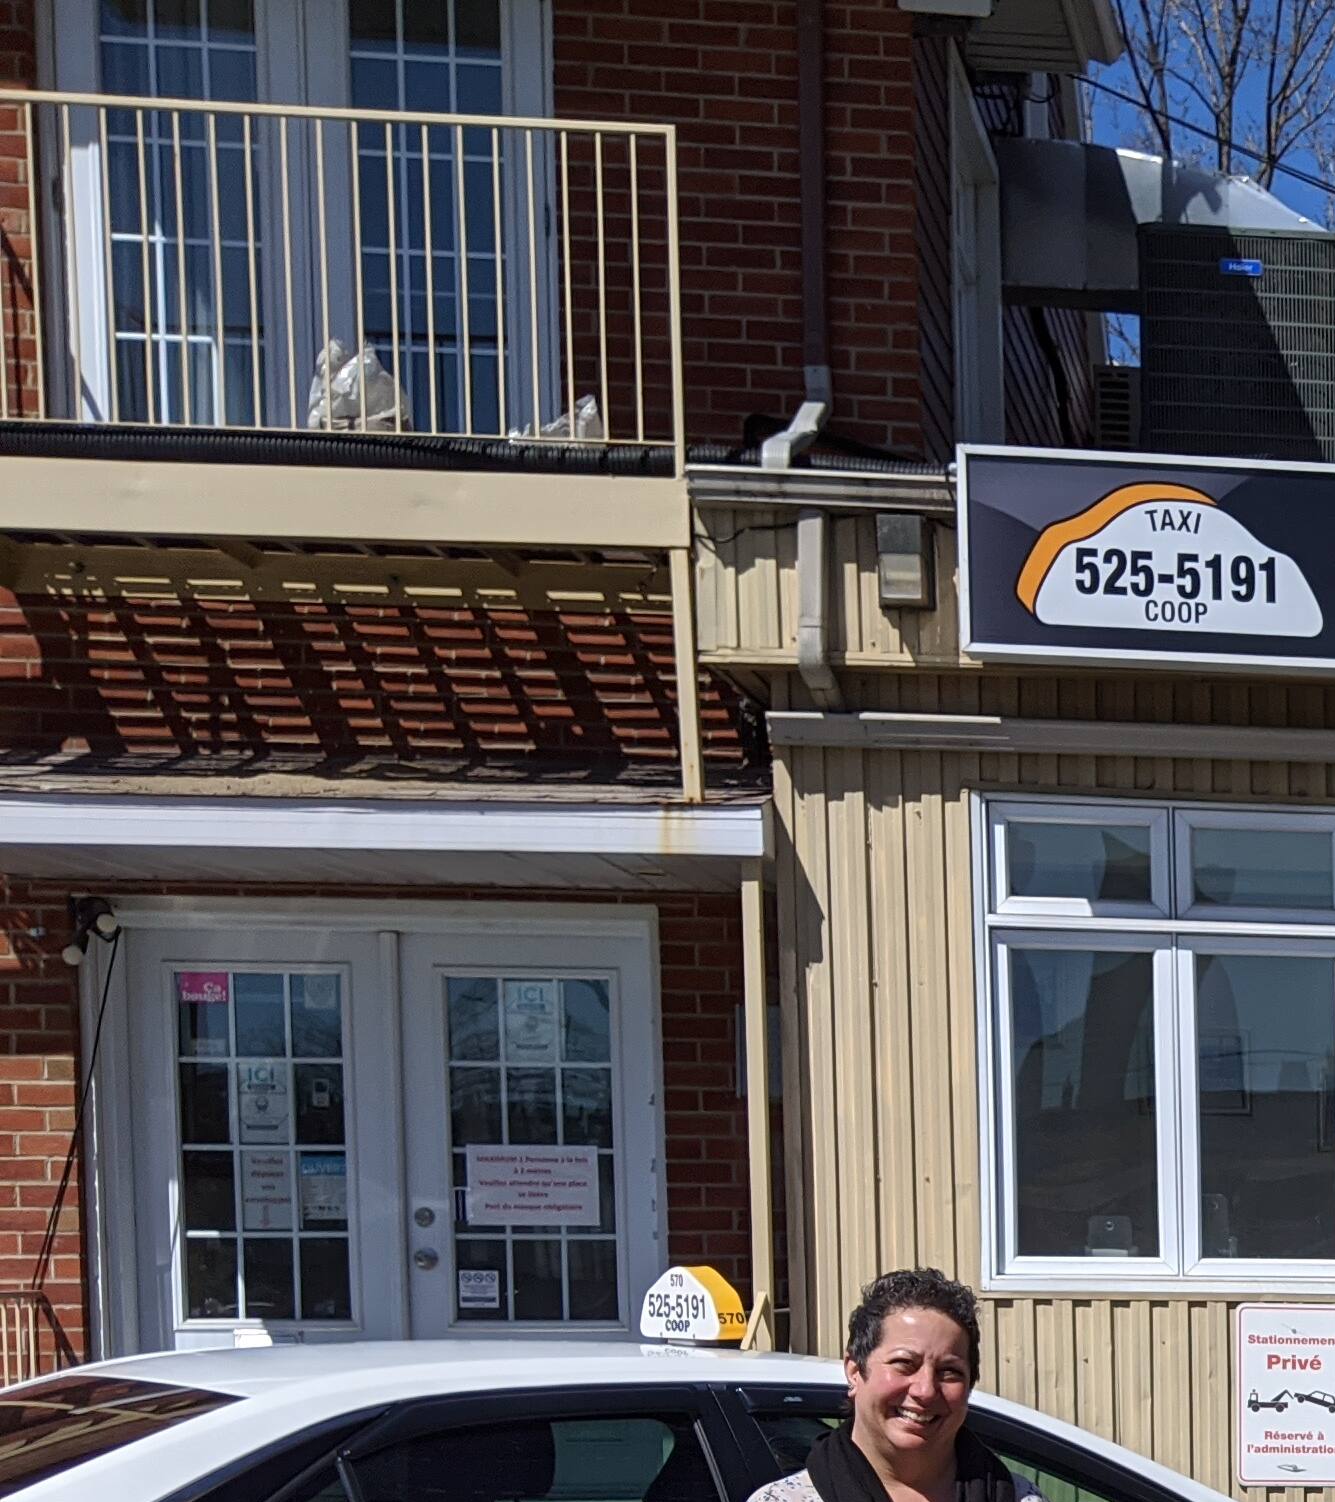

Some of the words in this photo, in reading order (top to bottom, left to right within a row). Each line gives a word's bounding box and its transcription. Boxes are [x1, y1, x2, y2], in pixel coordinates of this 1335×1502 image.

[1145, 509, 1201, 534] TAXI
[1075, 547, 1276, 604] 525-5191
[1145, 600, 1208, 623] COOP
[670, 1274, 684, 1287] 570
[648, 1293, 706, 1319] 525-5191
[665, 1319, 690, 1332] COOP
[718, 1312, 745, 1324] 570
[1266, 1354, 1322, 1371] Privé
[1264, 1430, 1313, 1441] Réservé
[1317, 1430, 1325, 1441] à
